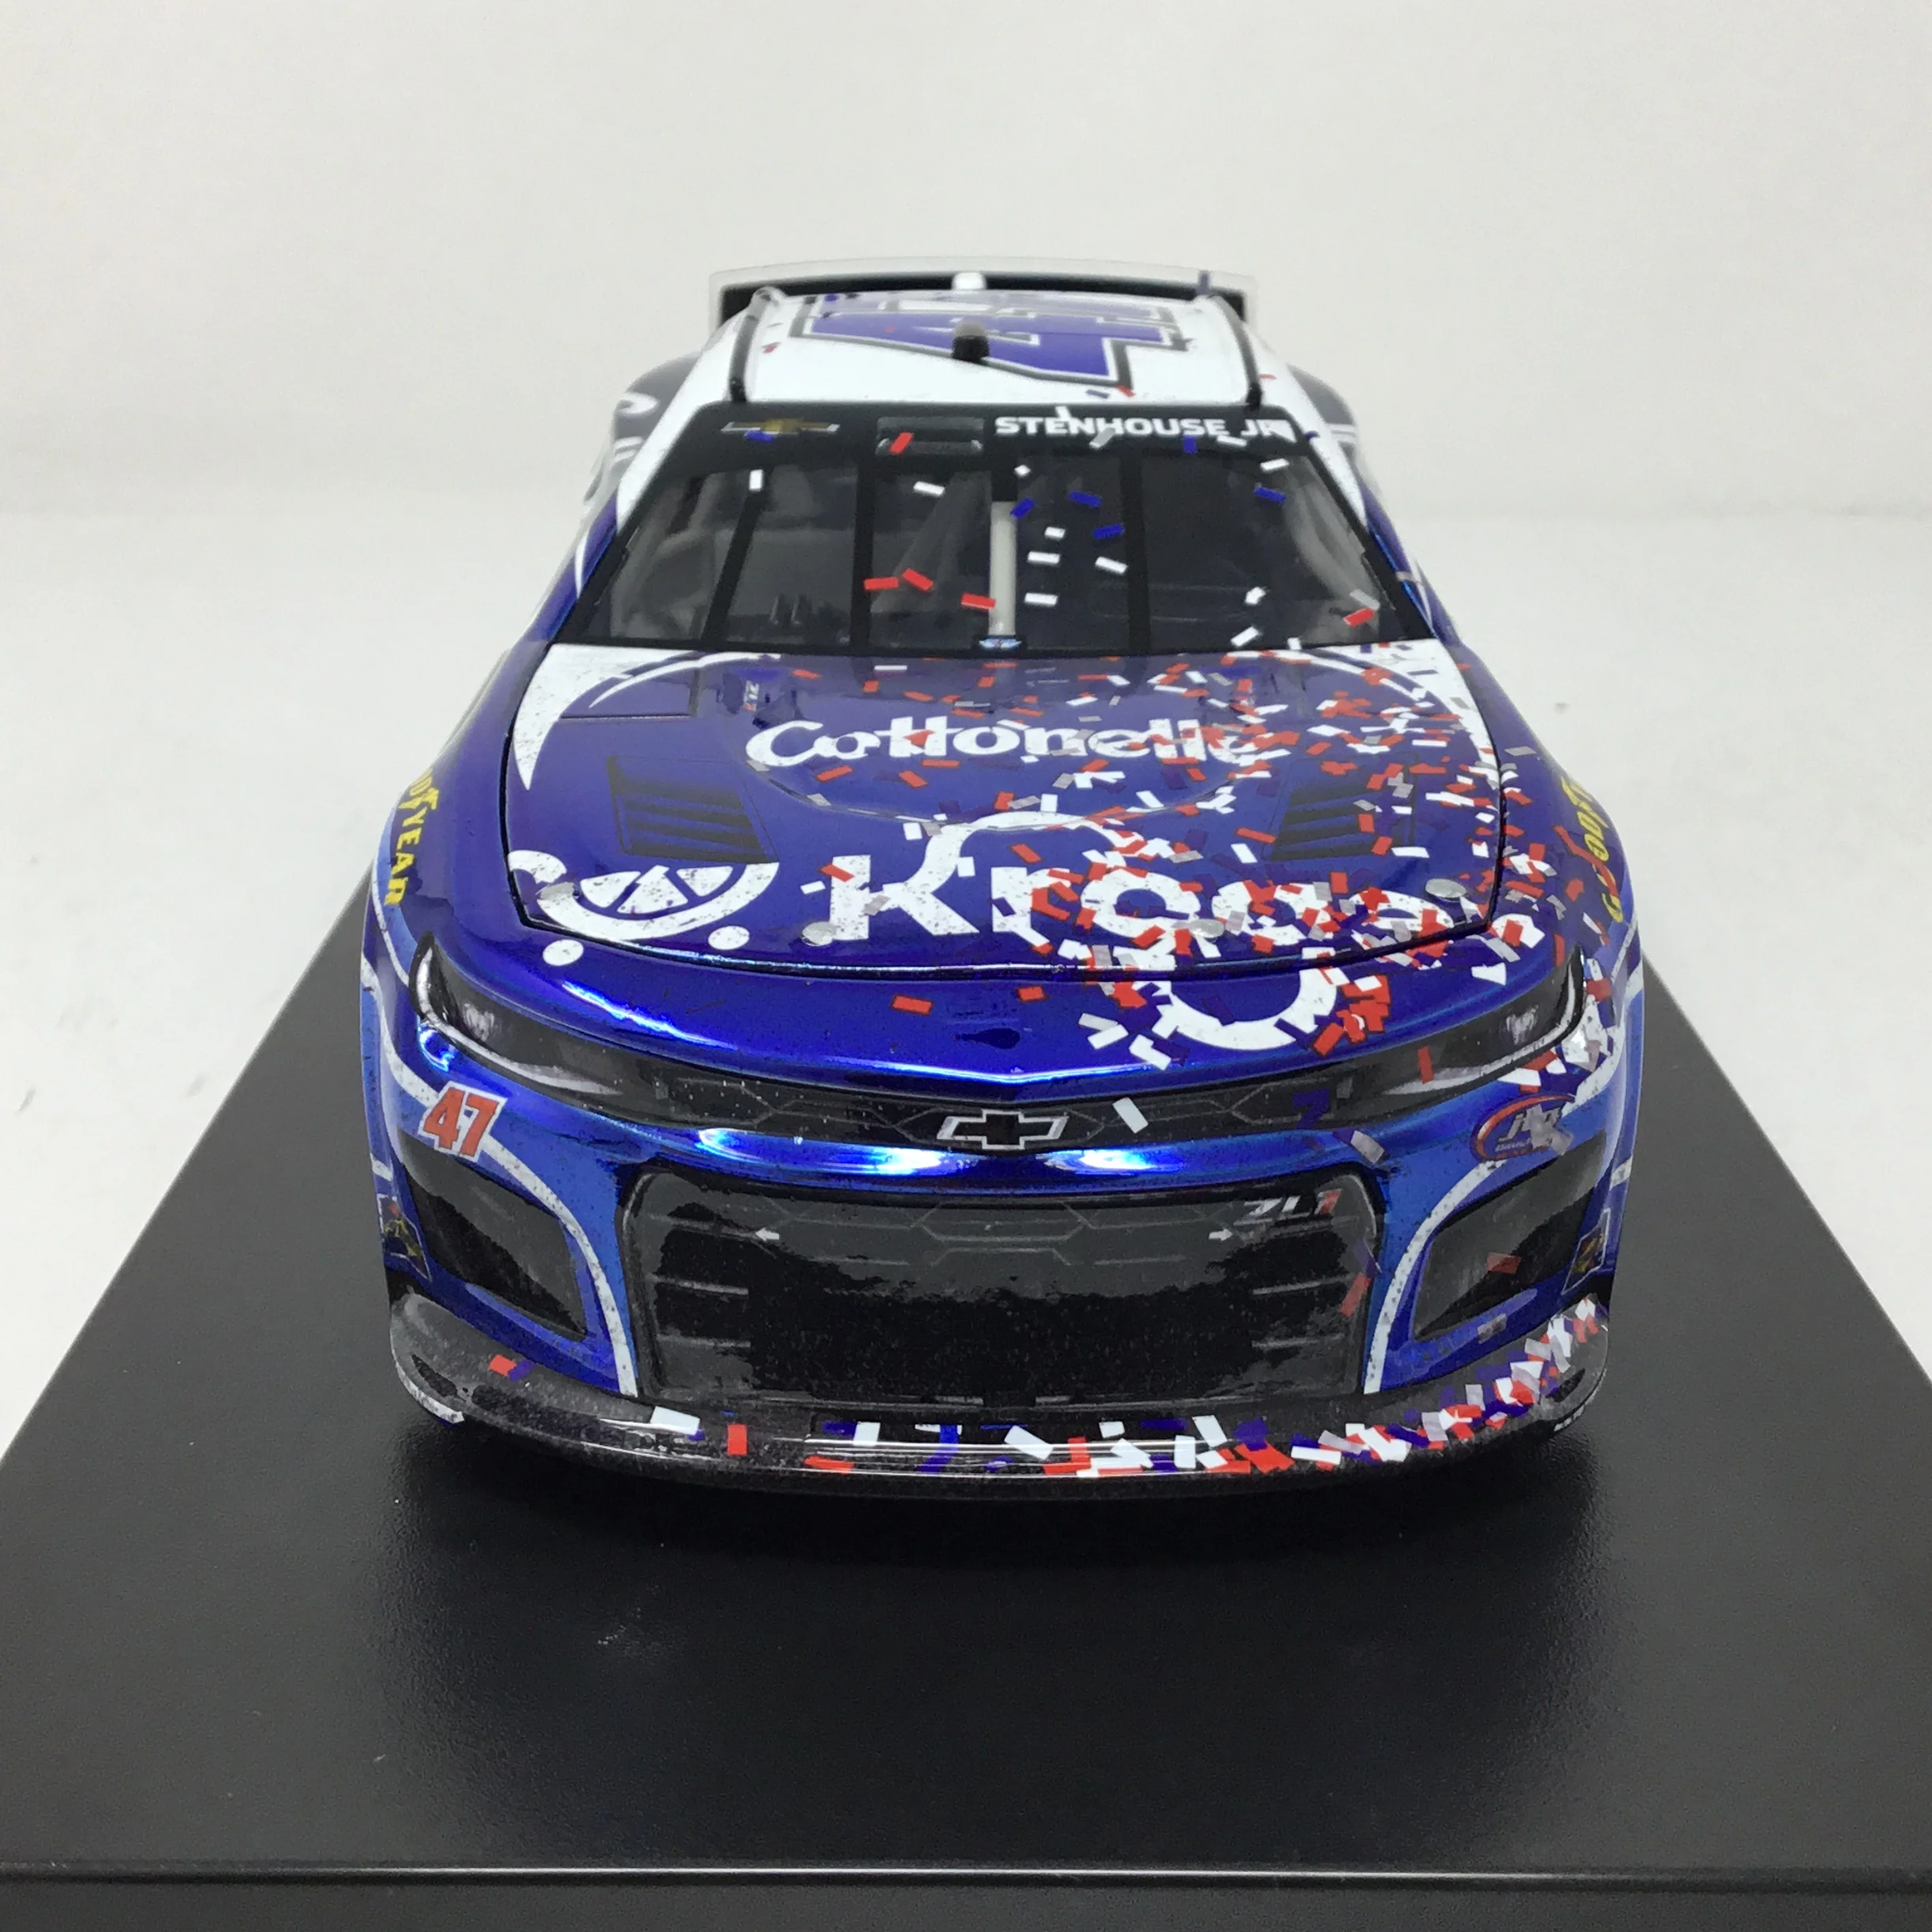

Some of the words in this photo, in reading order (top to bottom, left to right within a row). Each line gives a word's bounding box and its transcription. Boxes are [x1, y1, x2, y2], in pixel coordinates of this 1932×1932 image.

[995, 417, 1229, 436] STENHOUSE
[746, 716, 1261, 767] Cottonelle
[419, 1081, 507, 1161] 47
[1234, 1189, 1342, 1226] ZL1
